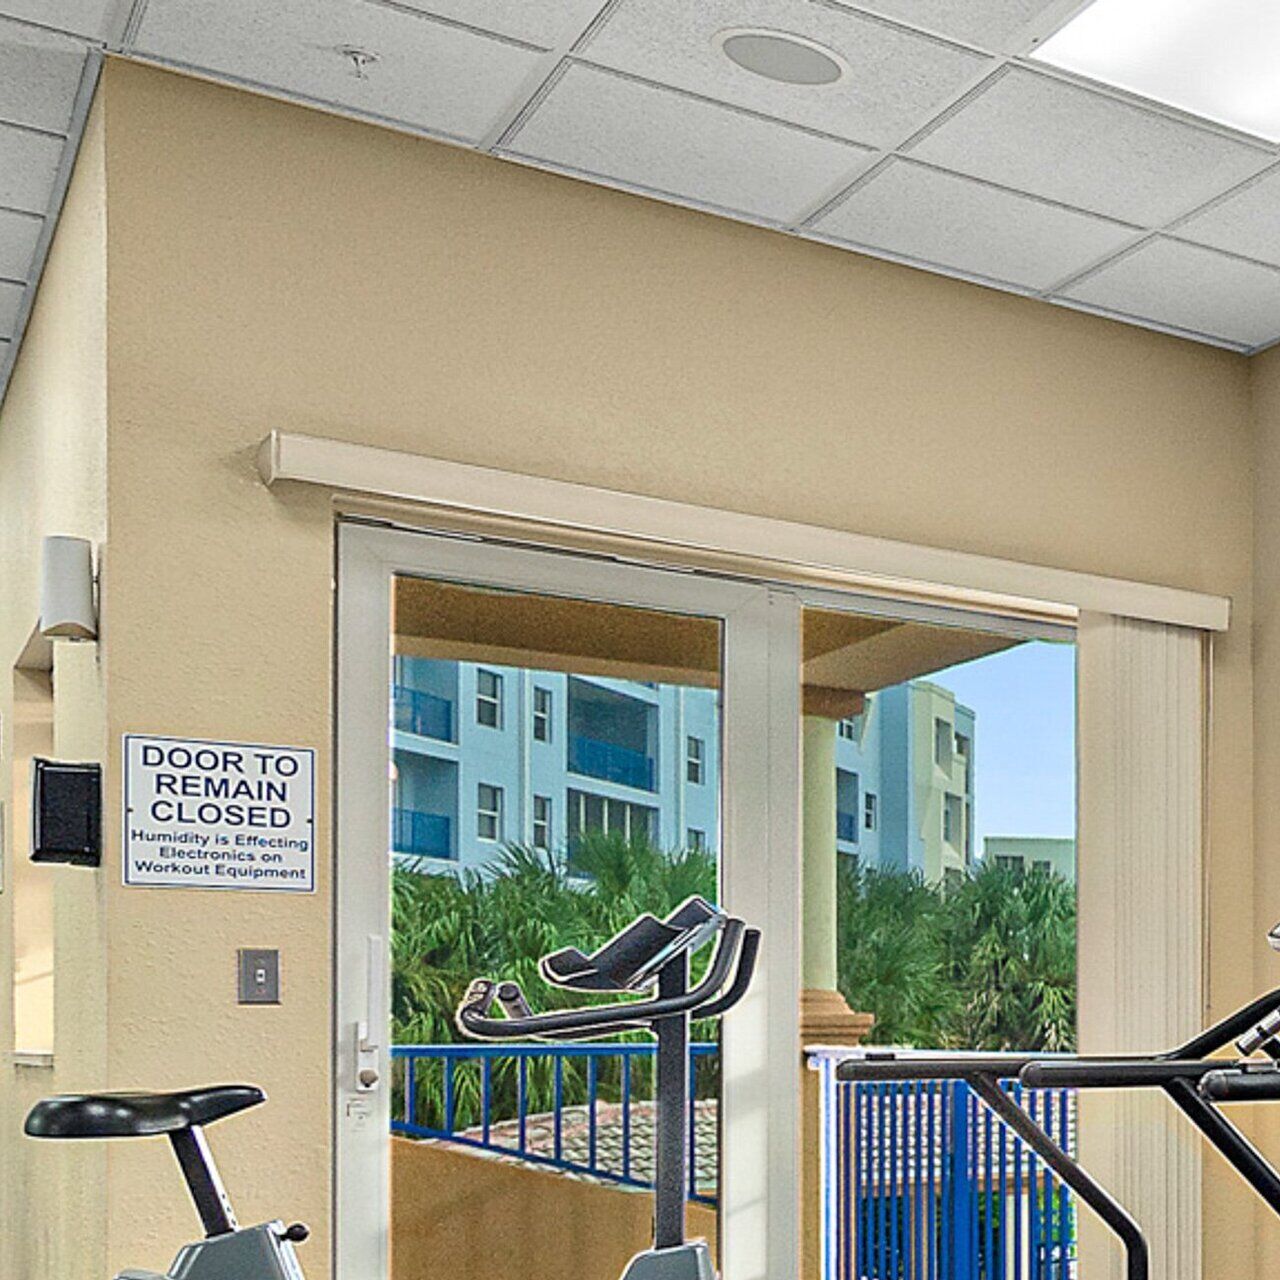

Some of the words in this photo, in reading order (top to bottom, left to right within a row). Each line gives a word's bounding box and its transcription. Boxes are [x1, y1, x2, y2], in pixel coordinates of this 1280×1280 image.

[142, 745, 244, 773] DOOR
[254, 753, 299, 777] TO
[155, 773, 287, 802] REMAIN
[151, 800, 291, 828] CLOSED
[131, 829, 210, 847] Humidity
[215, 834, 230, 846] is
[235, 834, 309, 852] Effecting
[159, 847, 256, 862] Electronics
[261, 853, 283, 863] on
[135, 860, 210, 876] Workout
[214, 863, 306, 880] Equipment
